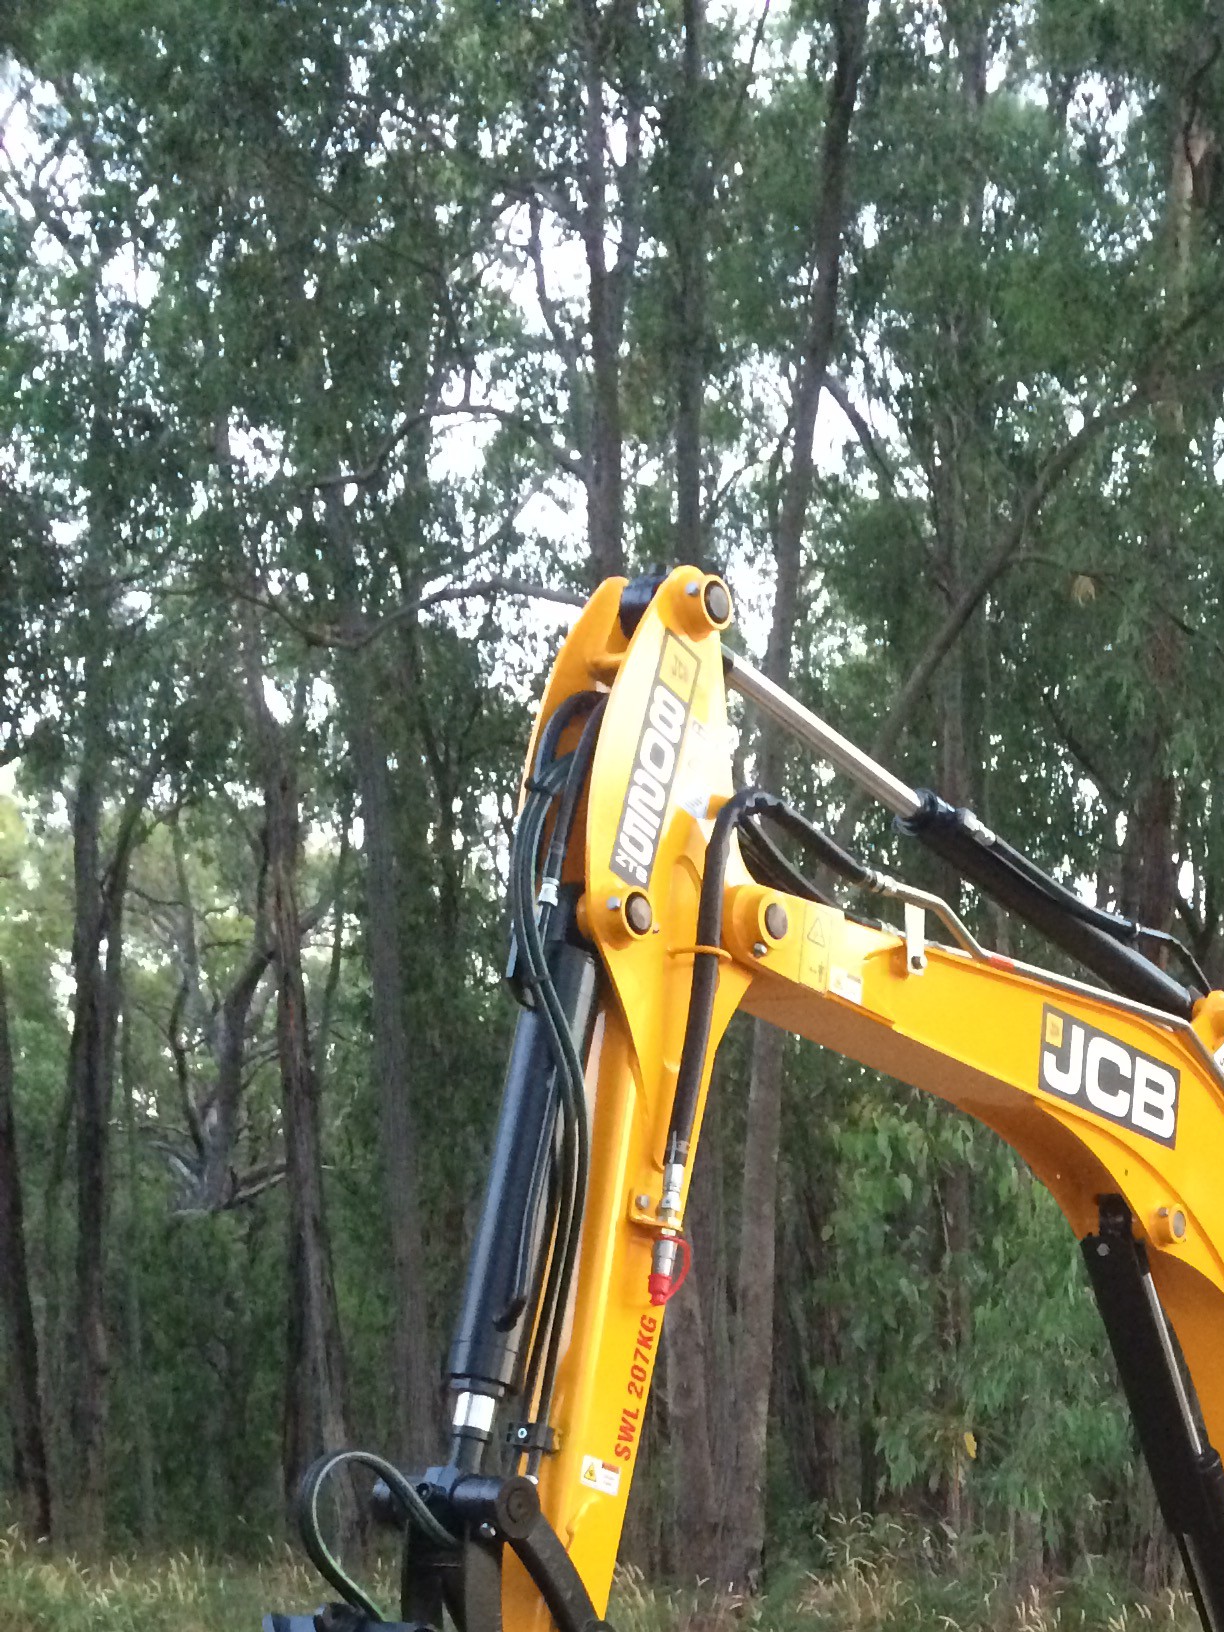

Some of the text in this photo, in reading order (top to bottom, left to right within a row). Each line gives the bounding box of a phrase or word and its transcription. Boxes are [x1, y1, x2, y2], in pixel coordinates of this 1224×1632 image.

[619, 685, 685, 866] 8025
[1043, 1024, 1176, 1139] JCB
[614, 1314, 657, 1461] SWL 207KG
